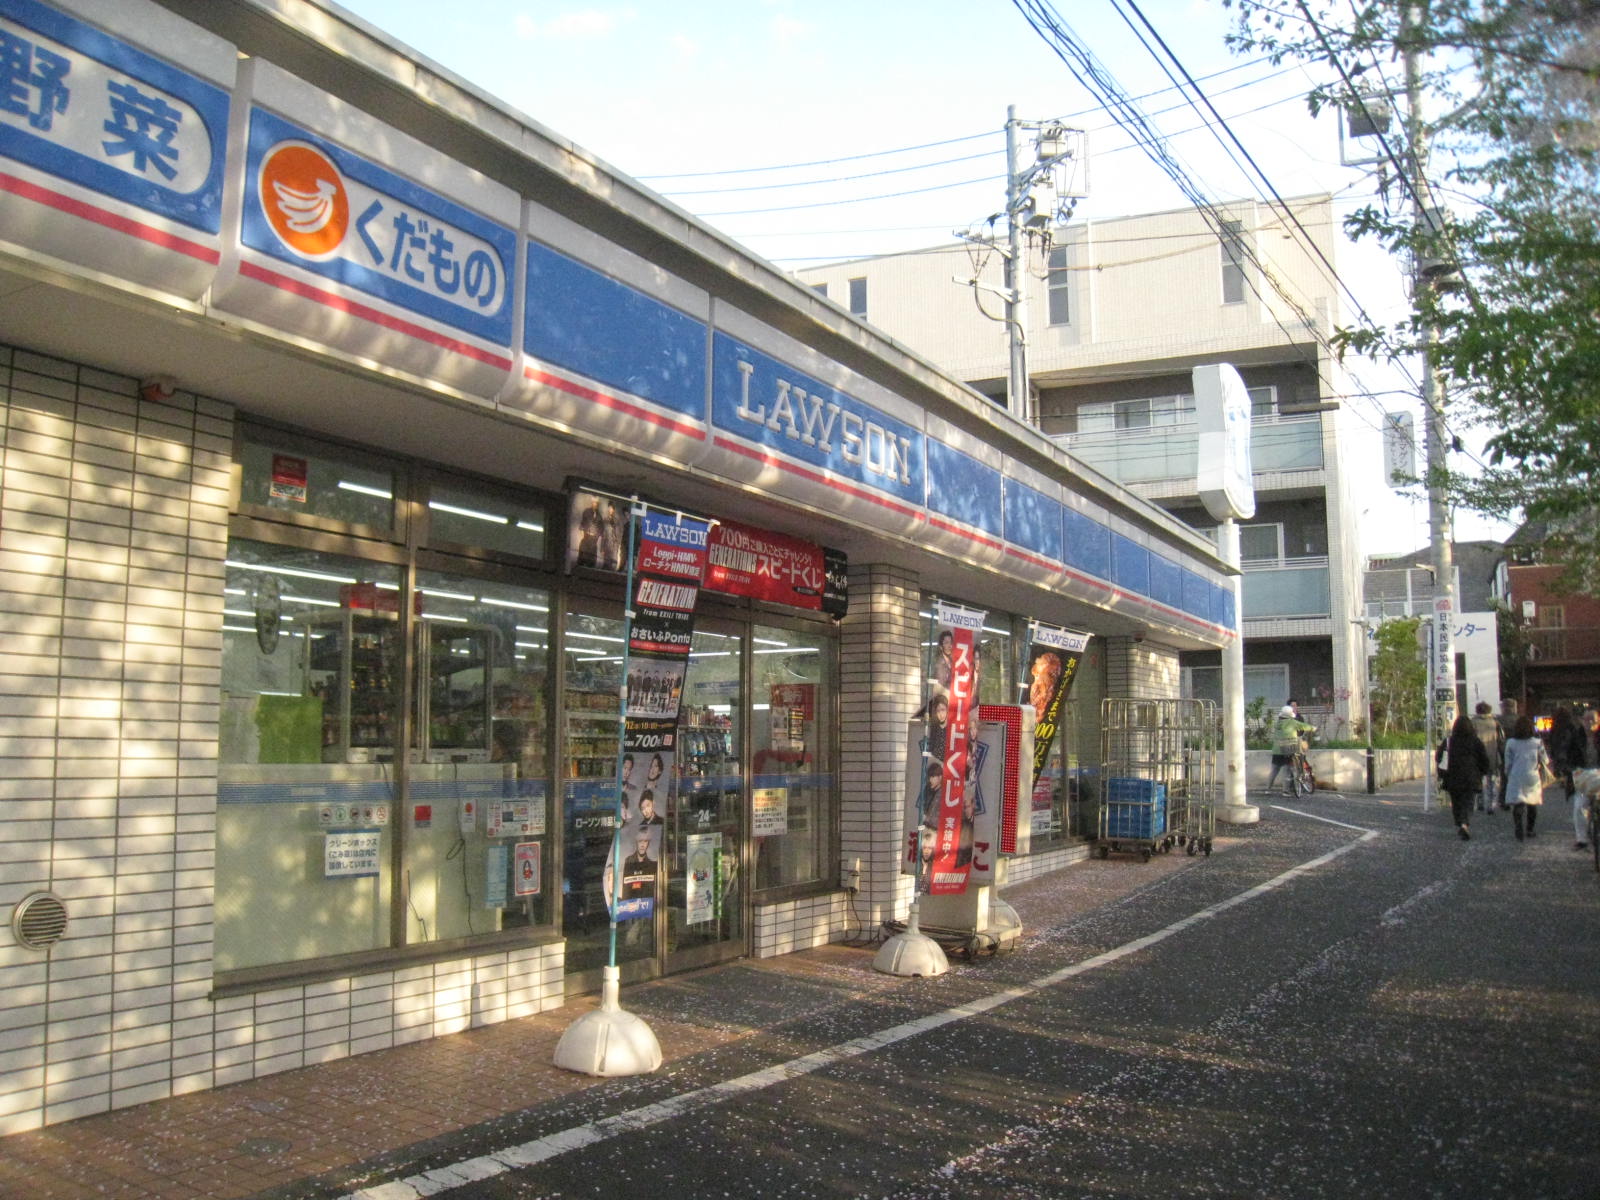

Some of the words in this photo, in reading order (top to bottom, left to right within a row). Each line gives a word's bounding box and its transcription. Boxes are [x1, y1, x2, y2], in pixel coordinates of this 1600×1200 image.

[0, 31, 182, 181] 野菜
[355, 199, 498, 306] くだもの
[736, 360, 911, 487] LAWSON
[645, 519, 708, 547] LAWSON
[758, 555, 822, 589] スピードくじ
[943, 611, 981, 628] LAWSON
[630, 627, 690, 644] おさいふPonta
[1036, 631, 1083, 649] LAWSON
[945, 643, 970, 808] スピードくじ
[698, 809, 711, 822] 24
